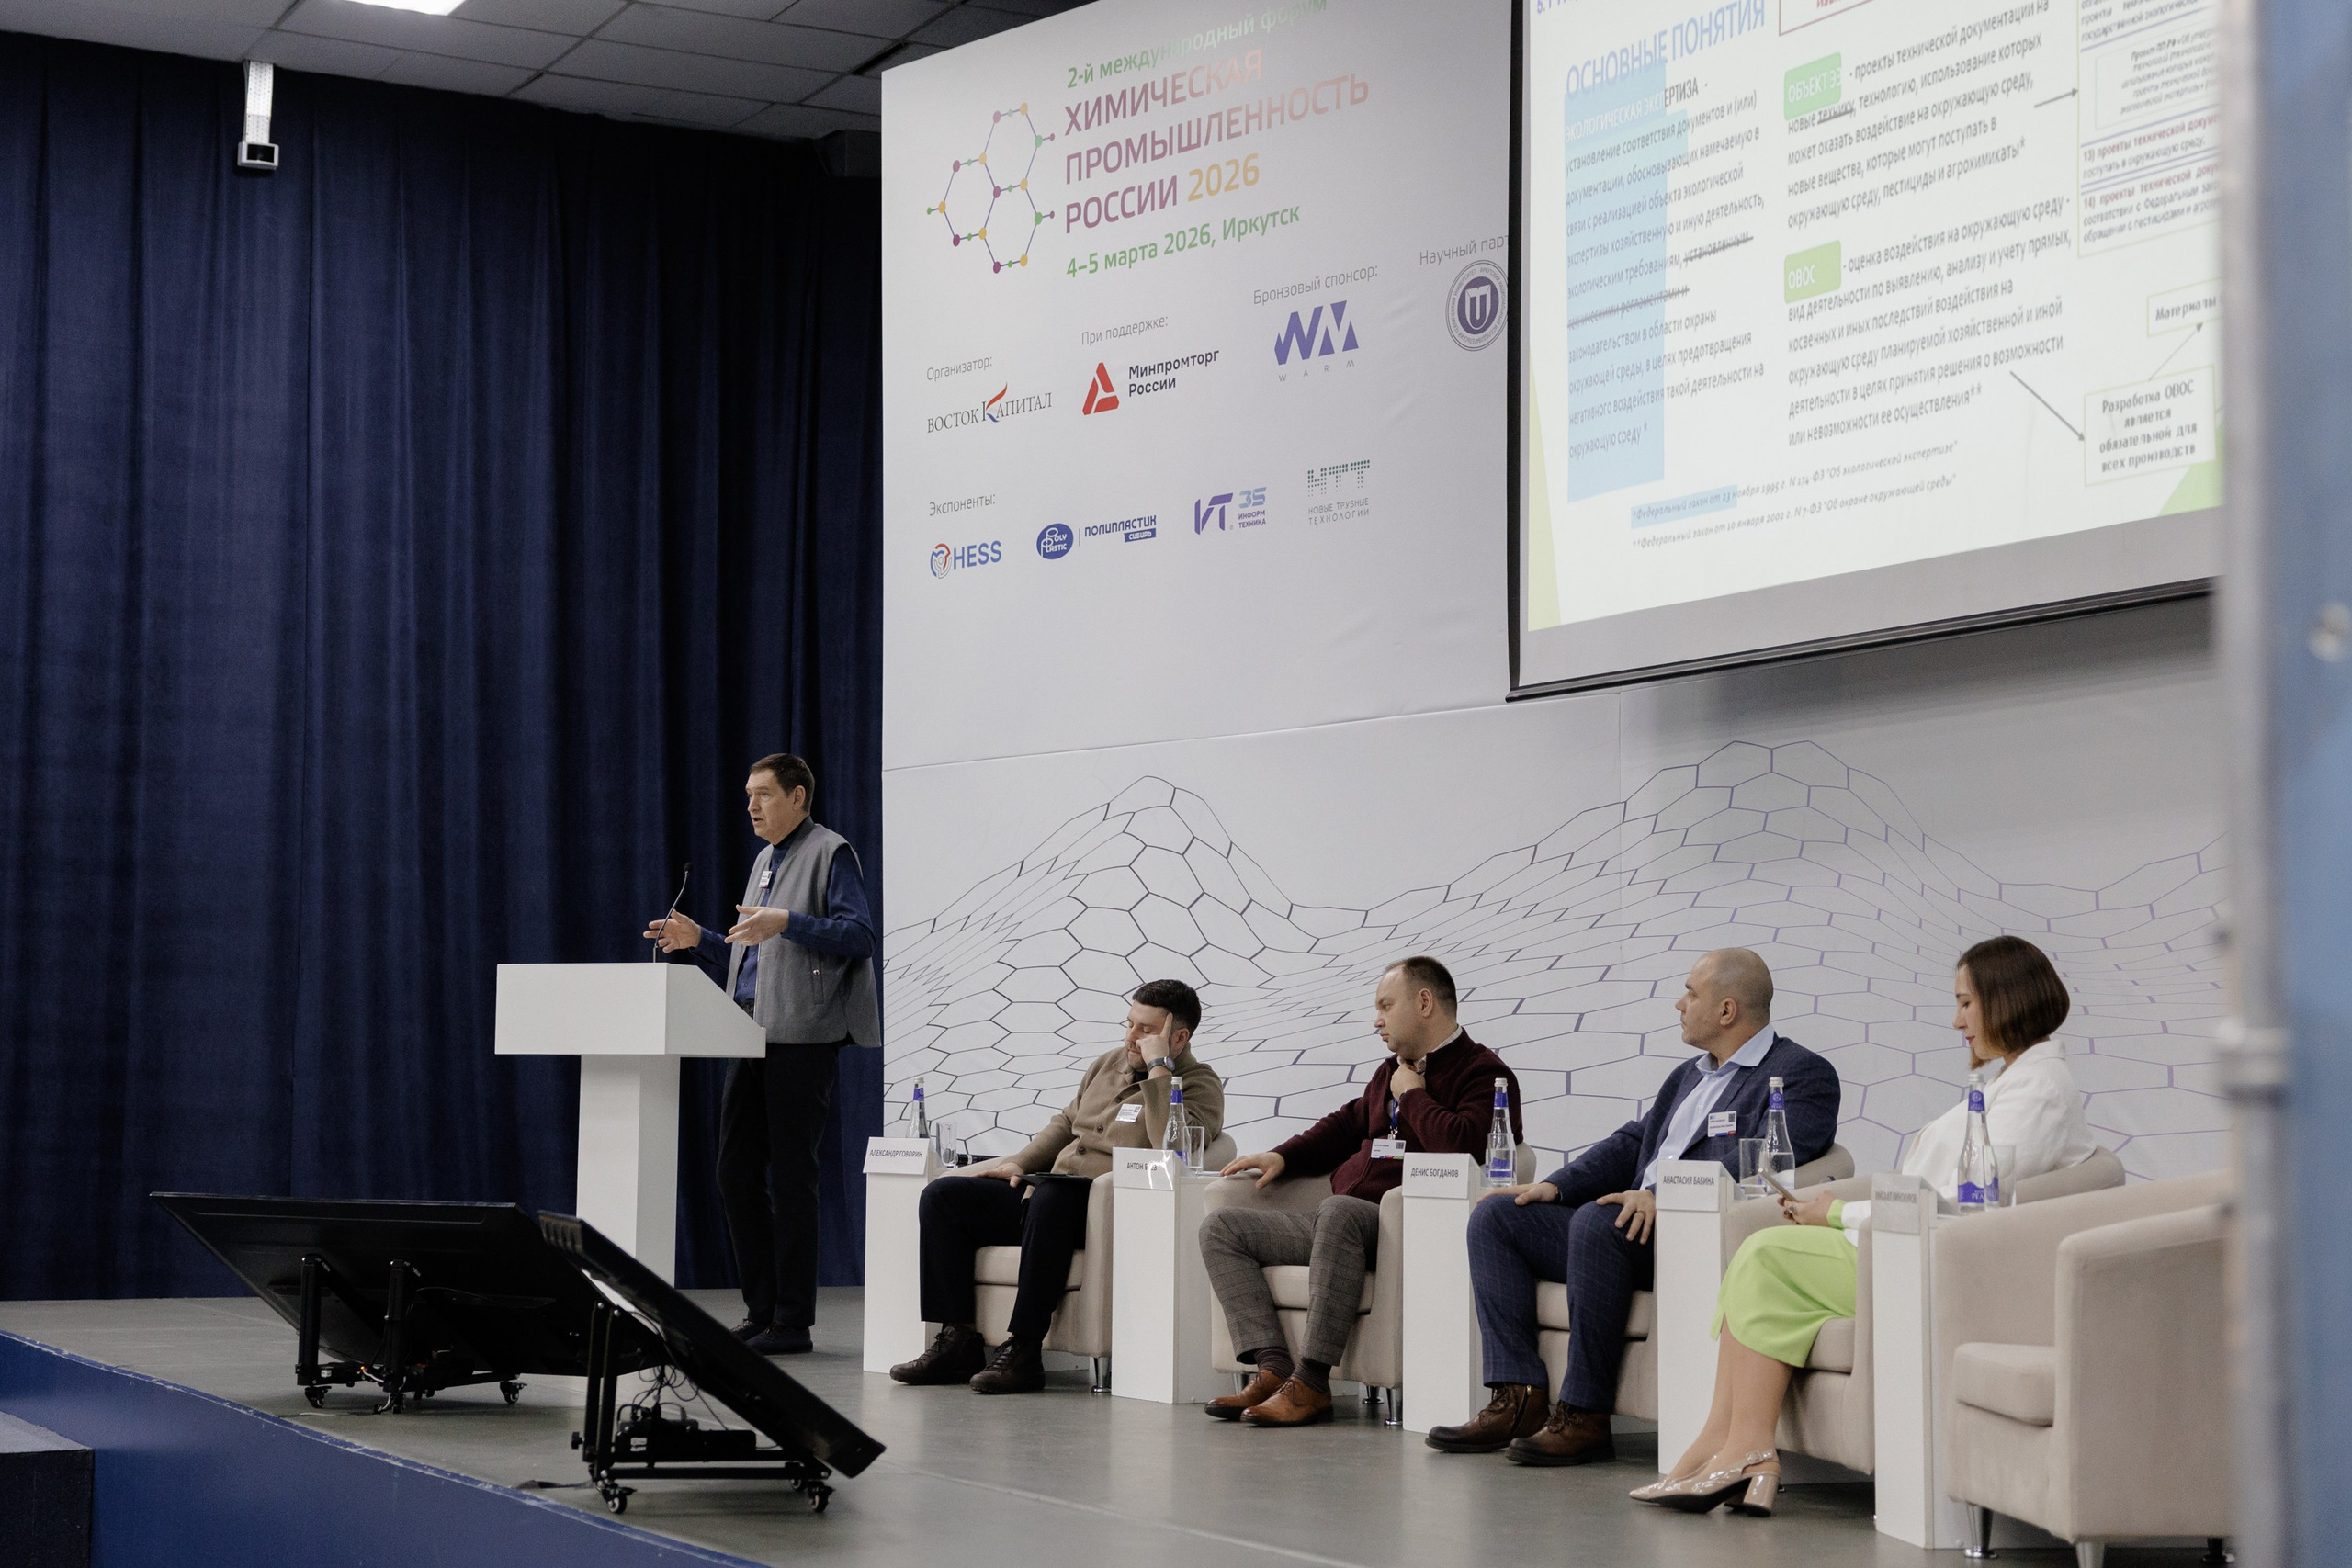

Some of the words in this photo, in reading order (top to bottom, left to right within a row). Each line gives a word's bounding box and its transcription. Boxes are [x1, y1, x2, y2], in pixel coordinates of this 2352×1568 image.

[1067, 62, 1094, 88] 2-й
[1100, 14, 1255, 79] международный
[1566, 29, 1668, 100] ОСНОВНЫЕ
[1673, 0, 1765, 61] ПОНЯТИЯ
[1788, 72, 1827, 104] ОБЪЕКТ
[1855, 51, 1894, 83] проекты
[1897, 25, 1958, 65] технической
[1959, 2, 2035, 45] документации
[1064, 49, 1263, 136] ХИМИЧЕСКАЯ
[1788, 113, 1816, 136] новые
[1859, 79, 1918, 111] технологию,
[1920, 51, 1996, 88] использование
[1997, 33, 2042, 62] которых
[1066, 73, 1369, 185] ПРОМЫШЛЕННОСТЬ
[1566, 101, 1643, 142] ЭКОЛОГИЧЕСКАЯ
[1566, 144, 1621, 178] установление
[1622, 125, 1676, 156] соответствия
[1677, 106, 1725, 138] документов
[1734, 93, 1758, 117] (или)
[1788, 144, 1816, 165] может
[1817, 130, 1854, 154] оказать
[1856, 110, 1915, 143] воздействие
[1930, 84, 1998, 120] окружающую
[2000, 71, 2034, 94] среду,
[1566, 176, 1625, 209] документации,
[1626, 151, 1699, 186] обосновывающих
[1700, 130, 1752, 157] намечаемую
[1788, 175, 1816, 197] новые
[1817, 161, 1864, 189] вещества,
[1866, 148, 1905, 174] которые
[1907, 136, 1937, 160] могут
[1938, 120, 1988, 149] поступать
[1067, 175, 1177, 233] РОССИИ
[1188, 152, 1260, 202] 2026
[1566, 220, 1587, 238] связи
[1592, 191, 1647, 232] реализацией
[1648, 187, 1682, 209] объекта
[1684, 161, 1744, 198] экологической
[1788, 196, 1849, 230] окружающую
[1851, 186, 1881, 211] среду,
[1883, 169, 1937, 199] пестициды
[1105, 243, 1158, 269] марта
[1164, 223, 1216, 254] 2026,
[1223, 206, 1300, 242] Иркутск
[1419, 241, 1476, 265] Научный
[1567, 240, 1609, 268] экспертизы
[1611, 222, 1674, 253] хозяйственную
[1683, 215, 1704, 231] иную
[1706, 194, 1765, 227] деятельность,
[1788, 265, 1815, 290] ОВОС
[1849, 251, 1882, 274] оценка
[1883, 231, 1946, 261] воздействия
[1962, 206, 2030, 242] окружающую
[2032, 195, 2064, 220] среду
[1254, 276, 1320, 306] Бронзовый
[1325, 266, 1377, 288] спонсор:
[1568, 268, 1623, 299] экологическим
[1625, 254, 1683, 284] требованиям,
[1806, 283, 1871, 321] деятельности
[1885, 264, 1943, 295] выявлению,
[1947, 251, 1987, 278] анализу
[1997, 241, 2026, 268] учету
[2028, 229, 2072, 255] прямых,
[1081, 331, 1102, 345] При
[1105, 316, 1168, 342] поддержке:
[1788, 329, 1837, 354] косвенных
[1846, 319, 1871, 337] иных
[1872, 296, 1934, 333] последствий
[1936, 278, 1998, 314] воздействия
[2156, 296, 2216, 321] Материалы
[1569, 332, 1642, 364] законодательством
[1649, 317, 1682, 339] области
[1685, 310, 1717, 331] охраны
[1789, 359, 1849, 386] окружающую
[1851, 347, 1878, 374] среду
[1881, 325, 1946, 363] планируемой
[1947, 306, 2024, 344] хозяйственной
[2035, 294, 2063, 319] иной
[927, 356, 992, 382] Организатор:
[1129, 350, 1219, 379] Минпромторг
[1569, 367, 1614, 395] окружающей
[1616, 361, 1644, 380] среды,
[1652, 352, 1677, 371] целях
[1678, 332, 1752, 367] предотвращения
[1789, 388, 1851, 420] деятельности
[1860, 376, 1888, 401] целях
[1889, 369, 1936, 394] принятия
[1937, 357, 1982, 386] решения
[1993, 335, 2064, 366] возможности
[927, 408, 978, 433] ВОСТОК
[982, 382, 1052, 423] КАПИТАЛ
[1129, 377, 1176, 397] России
[1569, 400, 1611, 427] негативного
[1613, 387, 1664, 414] воздействия
[1667, 376, 1690, 400] такой
[1691, 365, 1752, 398] деятельности
[2102, 390, 2161, 413] Разработка
[2165, 379, 2194, 400] ОВОС
[1789, 430, 1805, 447] или
[1807, 412, 1879, 443] невозможности
[2099, 425, 2171, 454] обязательной
[2177, 423, 2197, 438] для
[2124, 408, 2171, 429] является
[1569, 433, 1615, 459] окружающую
[1617, 427, 1642, 446] среду
[2102, 457, 2125, 473] всех
[2129, 443, 2196, 468] производств
[930, 494, 996, 516] Экспоненты:
[1084, 515, 1157, 537] ПОЛИПЛАСТИК
[1238, 510, 1265, 520] ИНФОРМ
[1238, 520, 1266, 528] ТЕХНИКА
[1308, 503, 1333, 514] НОВЫЕ
[1336, 498, 1369, 509] ТРУБНЫЕ
[1308, 509, 1369, 525] ТЕХНОЛОГИИ
[954, 540, 1001, 570] HESS
[870, 1149, 899, 1157] АЛЕКСАНДР
[1411, 1168, 1429, 1177] ДЕНИС
[1430, 1169, 1458, 1178] БОГДАНОВ
[1663, 1176, 1692, 1184] АНАСТАСИЯ
[1693, 1177, 1714, 1186] БАБИНА
